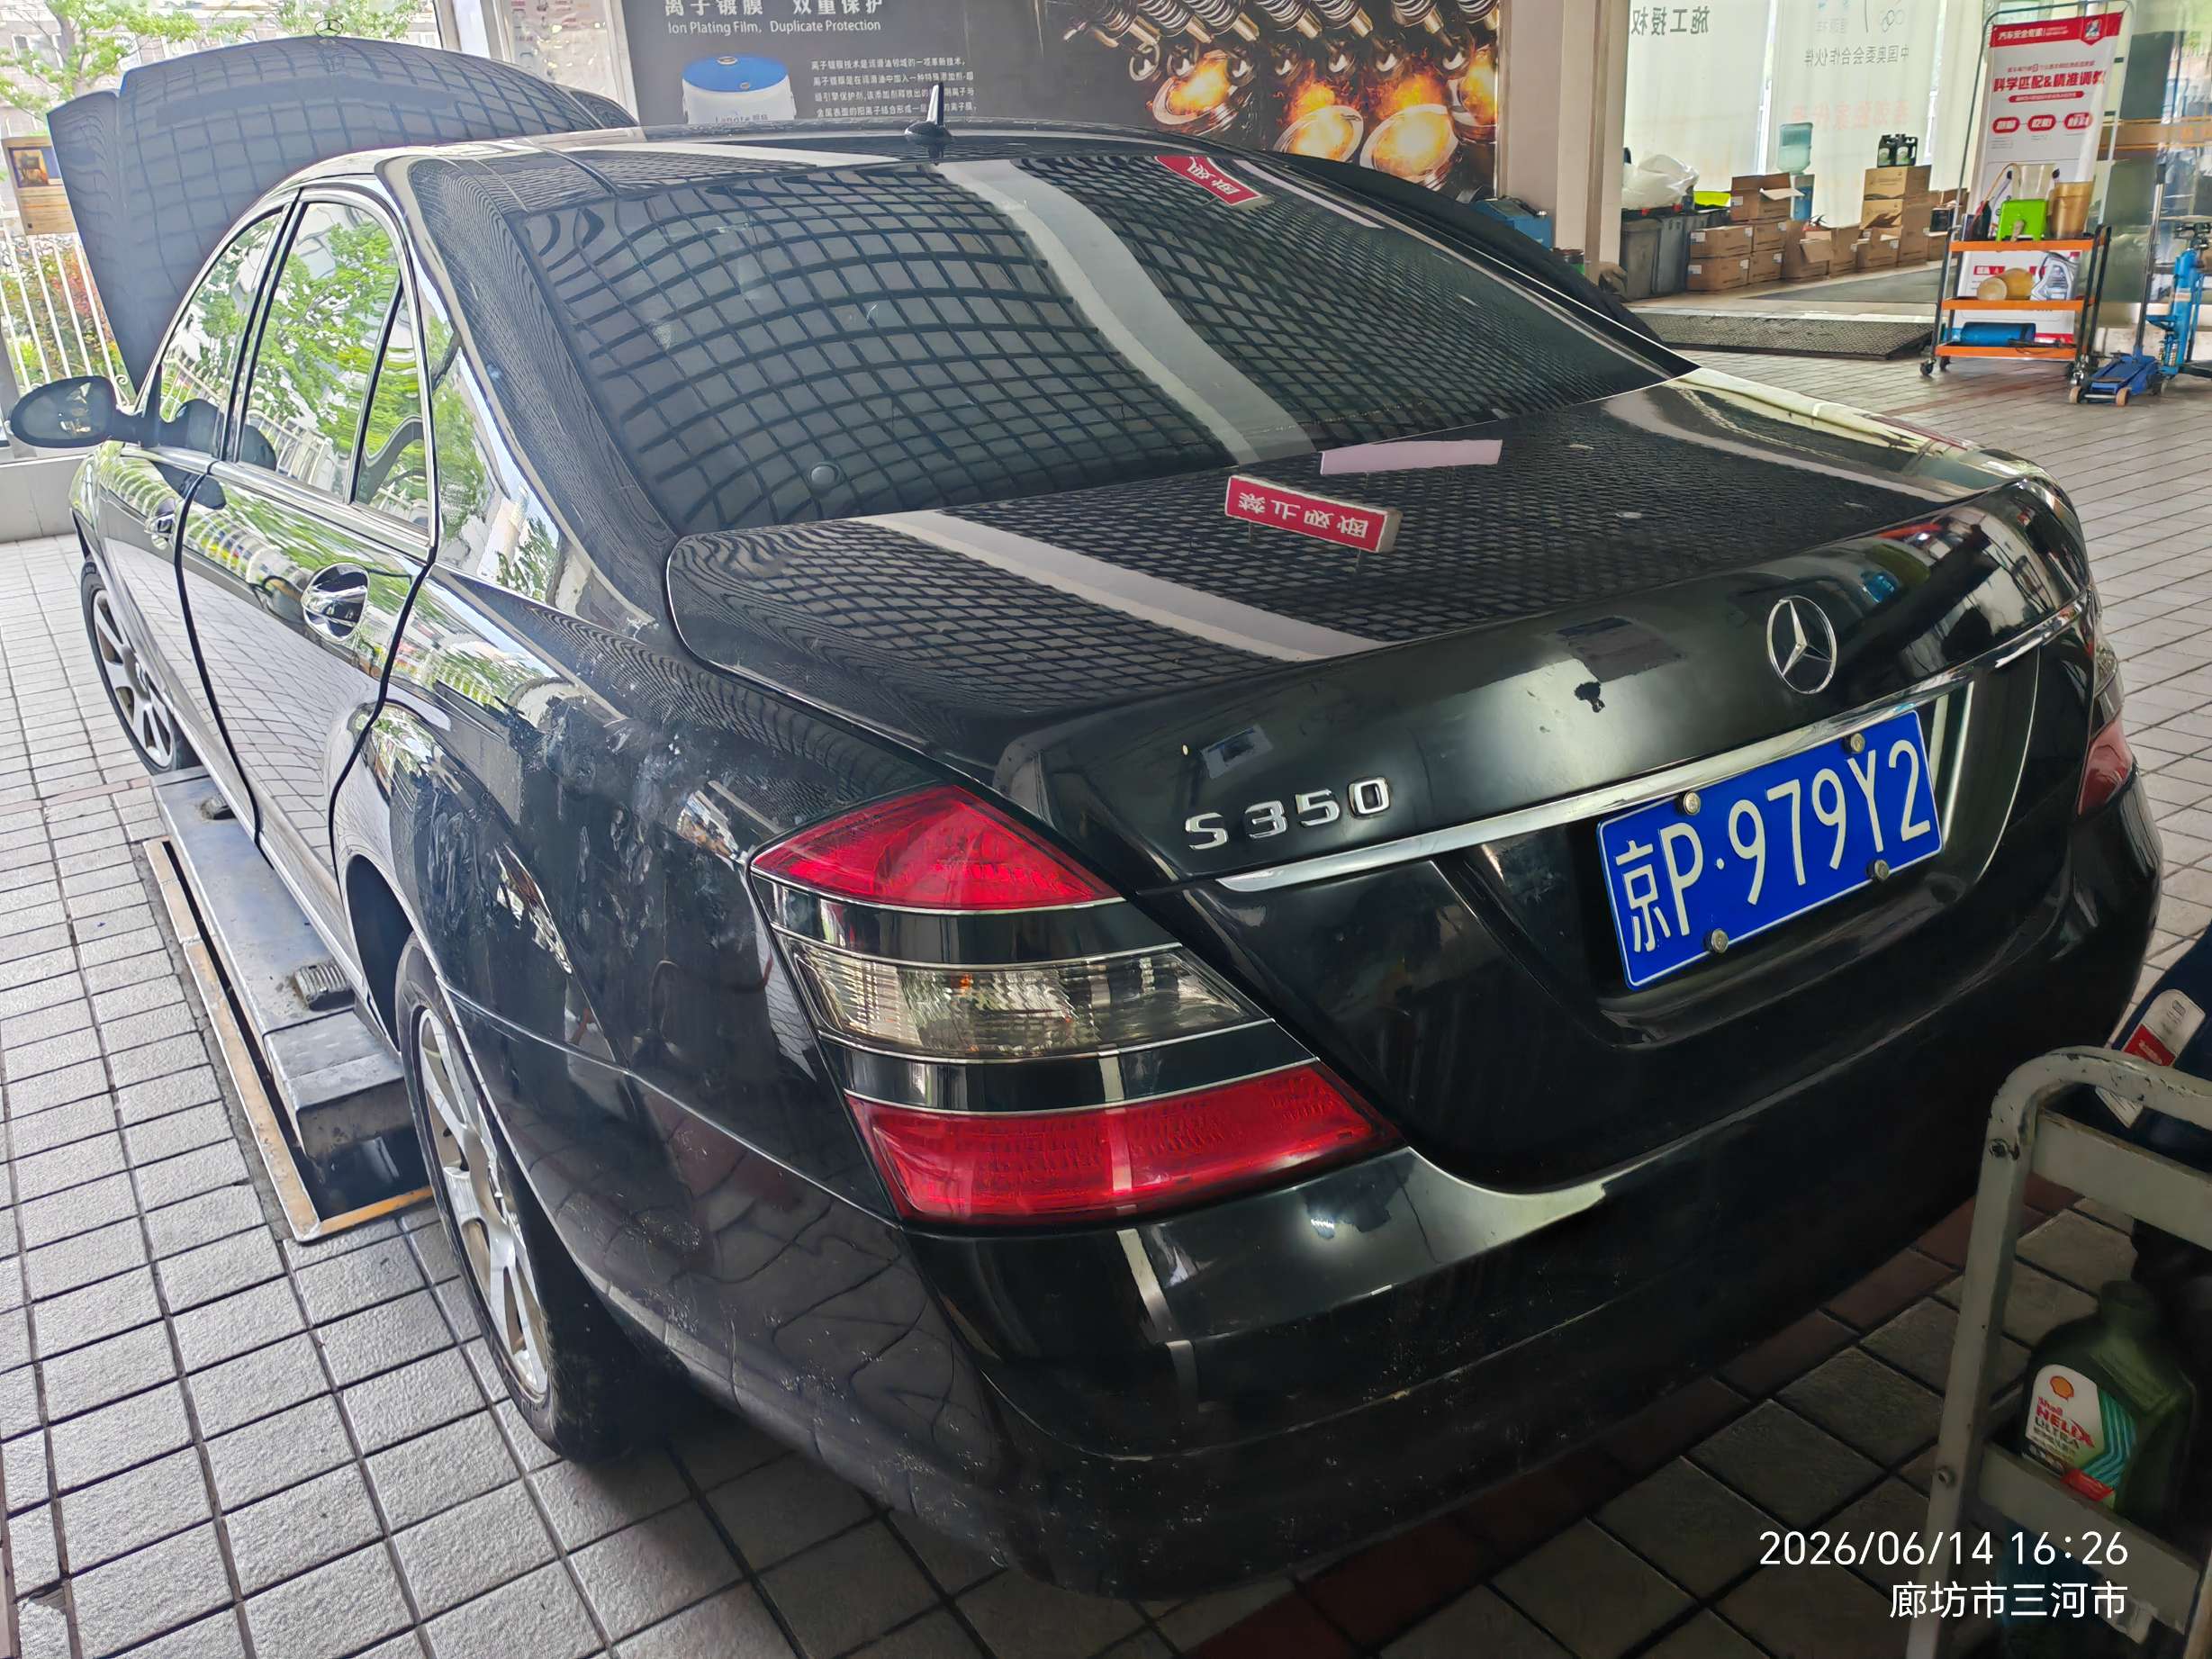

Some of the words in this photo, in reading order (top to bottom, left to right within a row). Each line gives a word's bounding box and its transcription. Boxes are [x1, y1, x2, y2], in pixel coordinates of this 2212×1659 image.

[664, 0, 763, 15] 离子镀膜
[793, 0, 882, 14] 双重保护
[668, 21, 687, 34] Ion
[690, 21, 731, 36] Plating
[770, 20, 823, 34] Duplicate
[825, 19, 881, 32] Protection
[1185, 811, 1229, 851] S
[1244, 776, 1391, 840] 350
